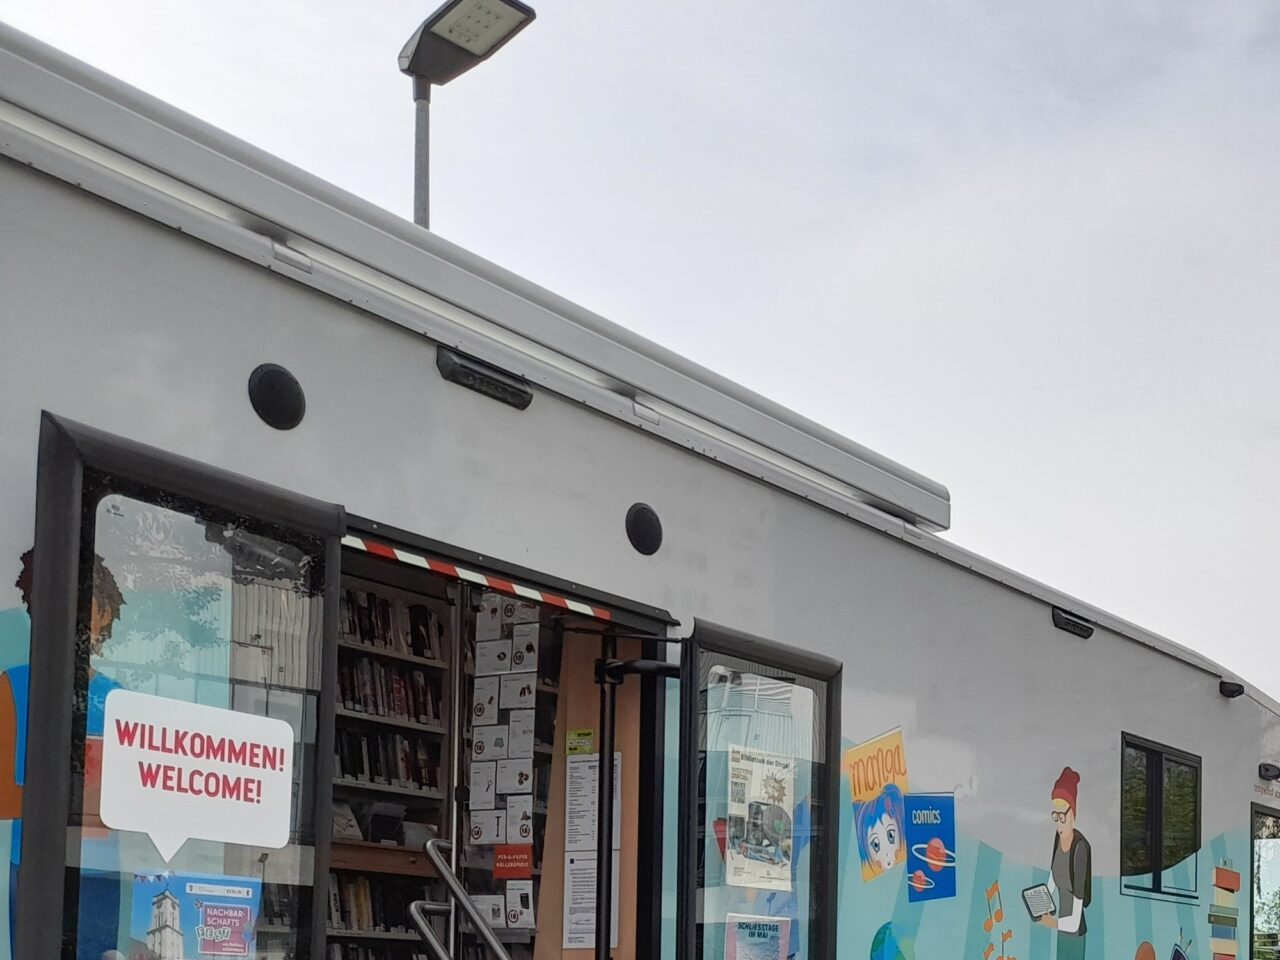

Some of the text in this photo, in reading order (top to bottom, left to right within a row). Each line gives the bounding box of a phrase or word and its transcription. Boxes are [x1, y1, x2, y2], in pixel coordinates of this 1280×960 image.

[115, 718, 285, 772] WILLKOMMEN!
[850, 744, 906, 797] manga
[138, 761, 262, 804] WELCOME!
[912, 806, 941, 825] comics
[206, 907, 246, 918] NACHBAR-
[206, 917, 240, 928] SCHAFTS
[196, 926, 231, 941] FEST
